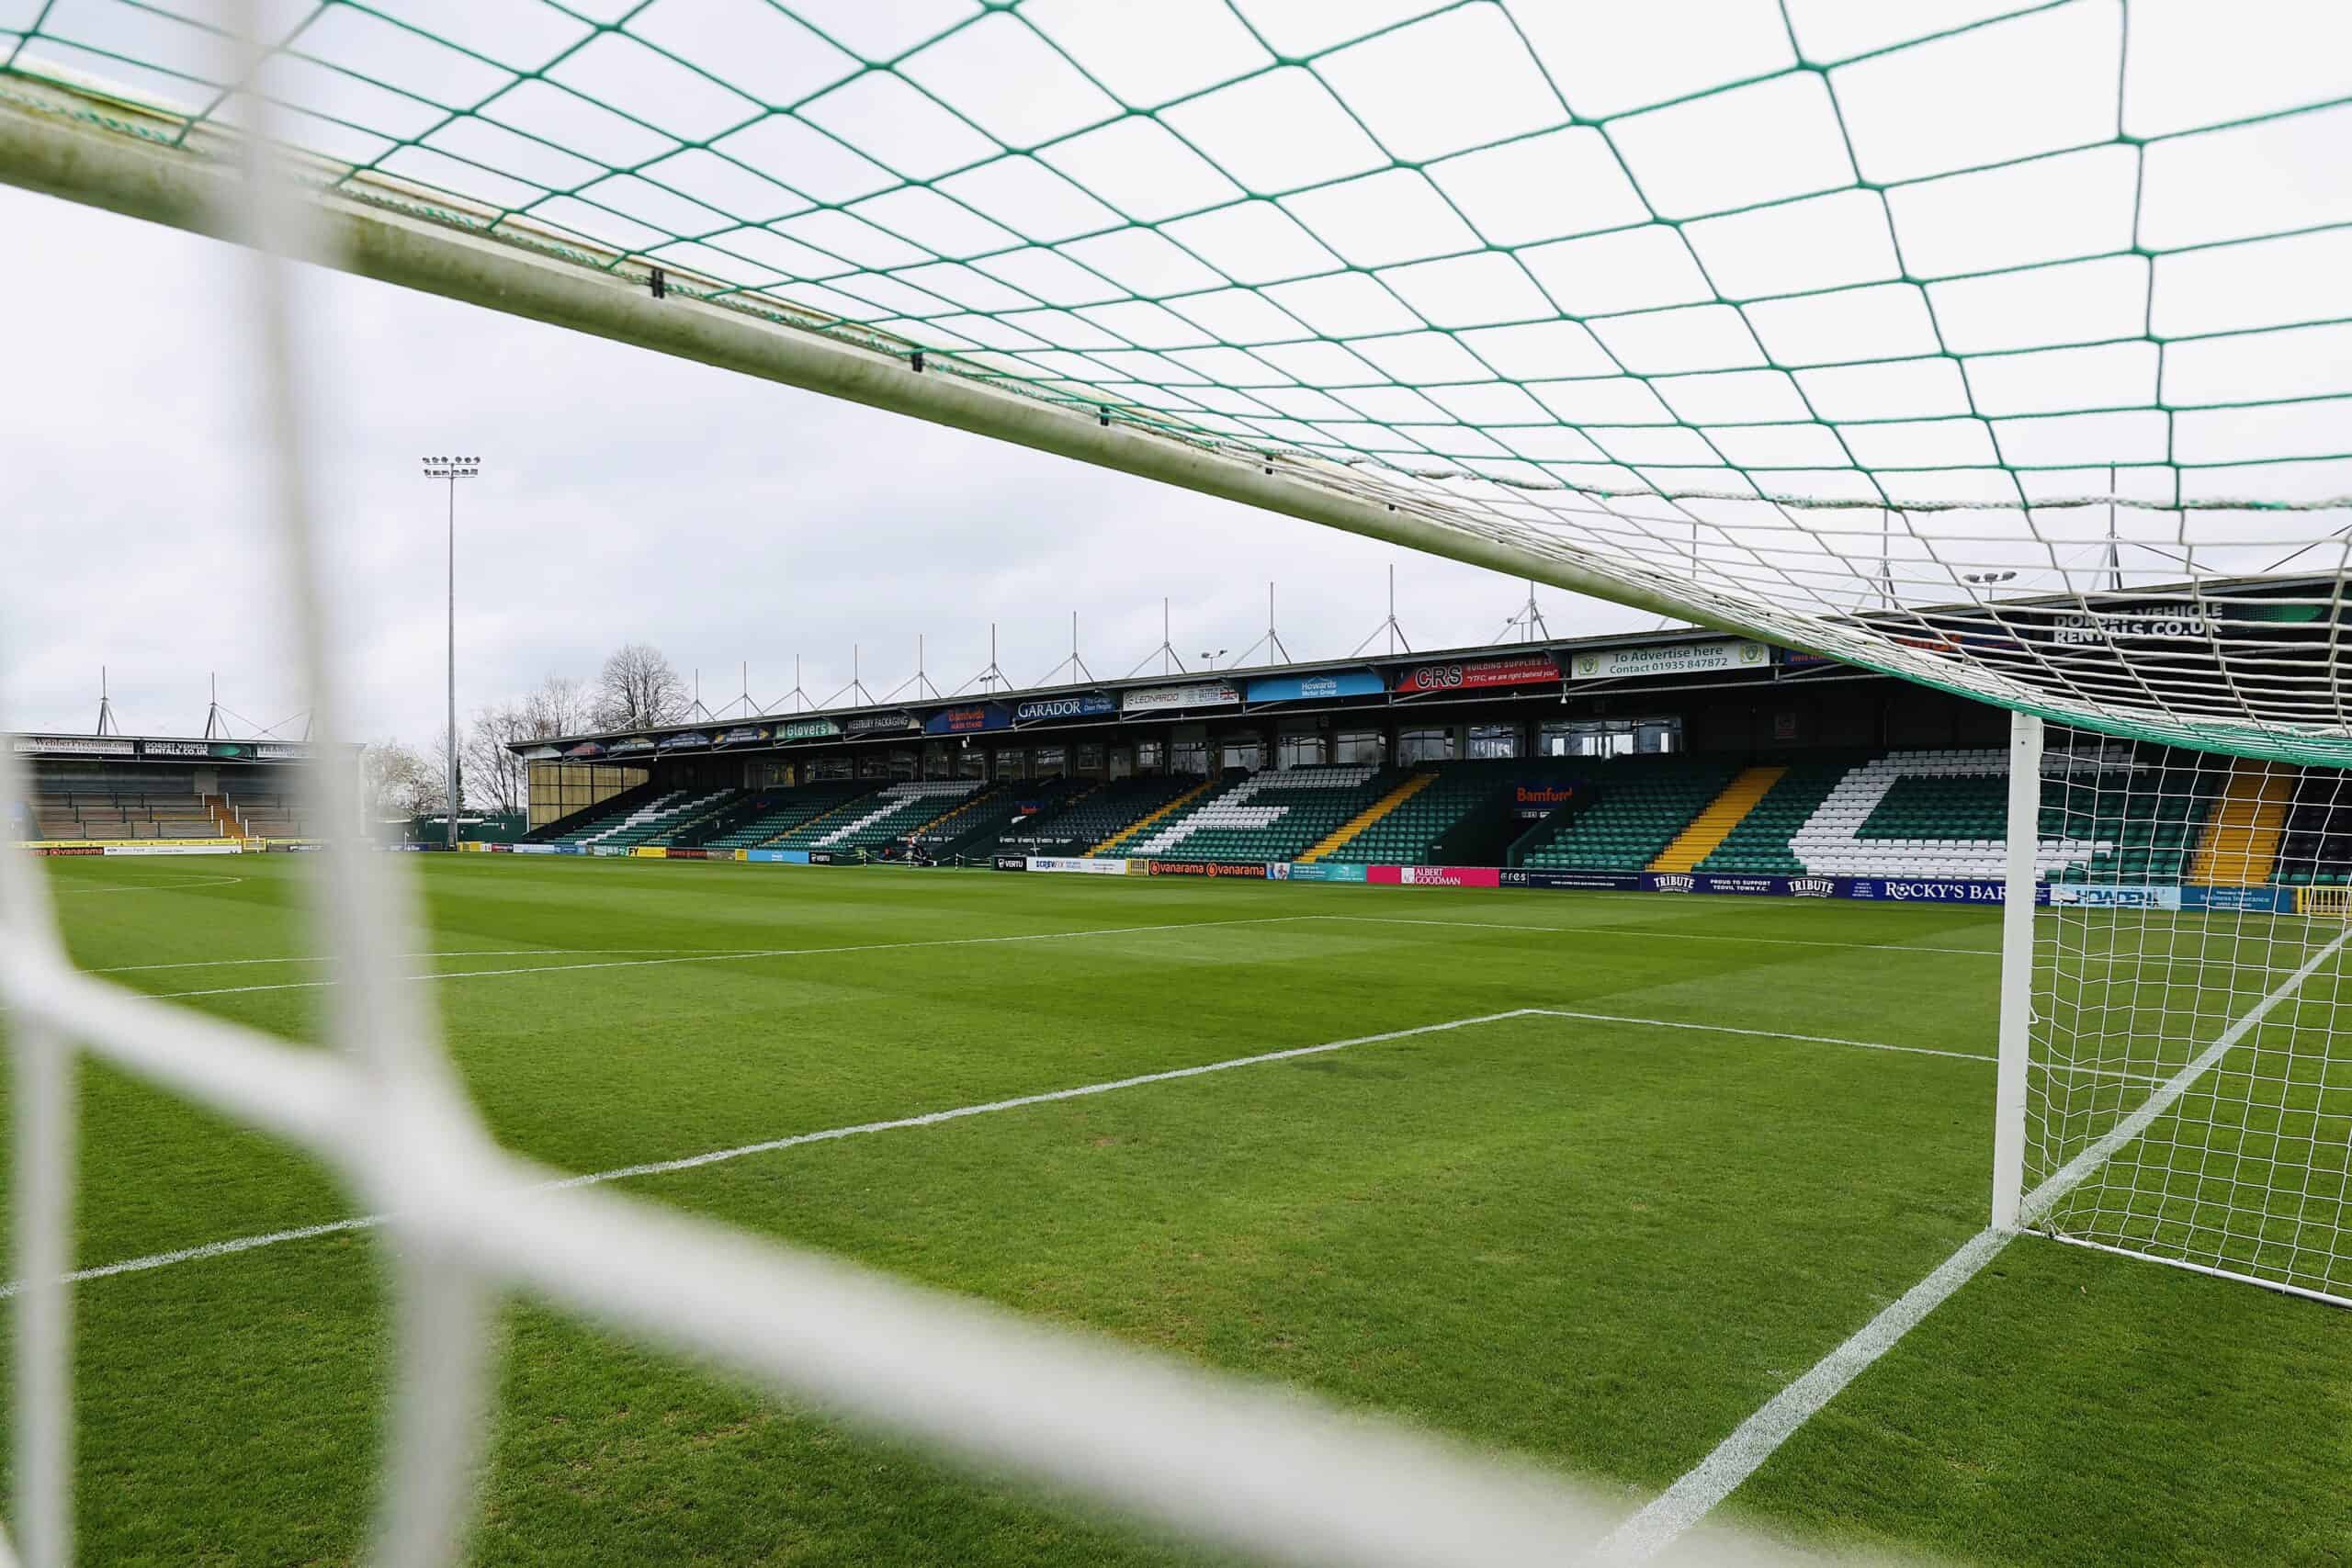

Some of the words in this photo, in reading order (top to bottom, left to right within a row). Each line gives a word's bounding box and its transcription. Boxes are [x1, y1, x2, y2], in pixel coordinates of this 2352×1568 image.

[1614, 653, 1628, 663] To
[1630, 649, 1690, 662] Advertise
[1693, 646, 1724, 658] here
[1610, 664, 1649, 674] Contact
[1652, 661, 1685, 671] 01935
[1688, 658, 1728, 669] 847872
[1416, 664, 1464, 689] CRS
[1301, 681, 1337, 691] Howards
[1017, 701, 1081, 718] GARADOR
[786, 724, 827, 737] Glovers
[1005, 860, 1023, 868] VERTU
[1159, 864, 1204, 874] vanarama
[1217, 865, 1265, 876] vanarama
[1416, 868, 1443, 876] ALBERT
[1416, 875, 1461, 886] GOODMAN
[1654, 875, 1696, 889] TRIBUTE
[1787, 879, 1835, 894] TRIBUTE
